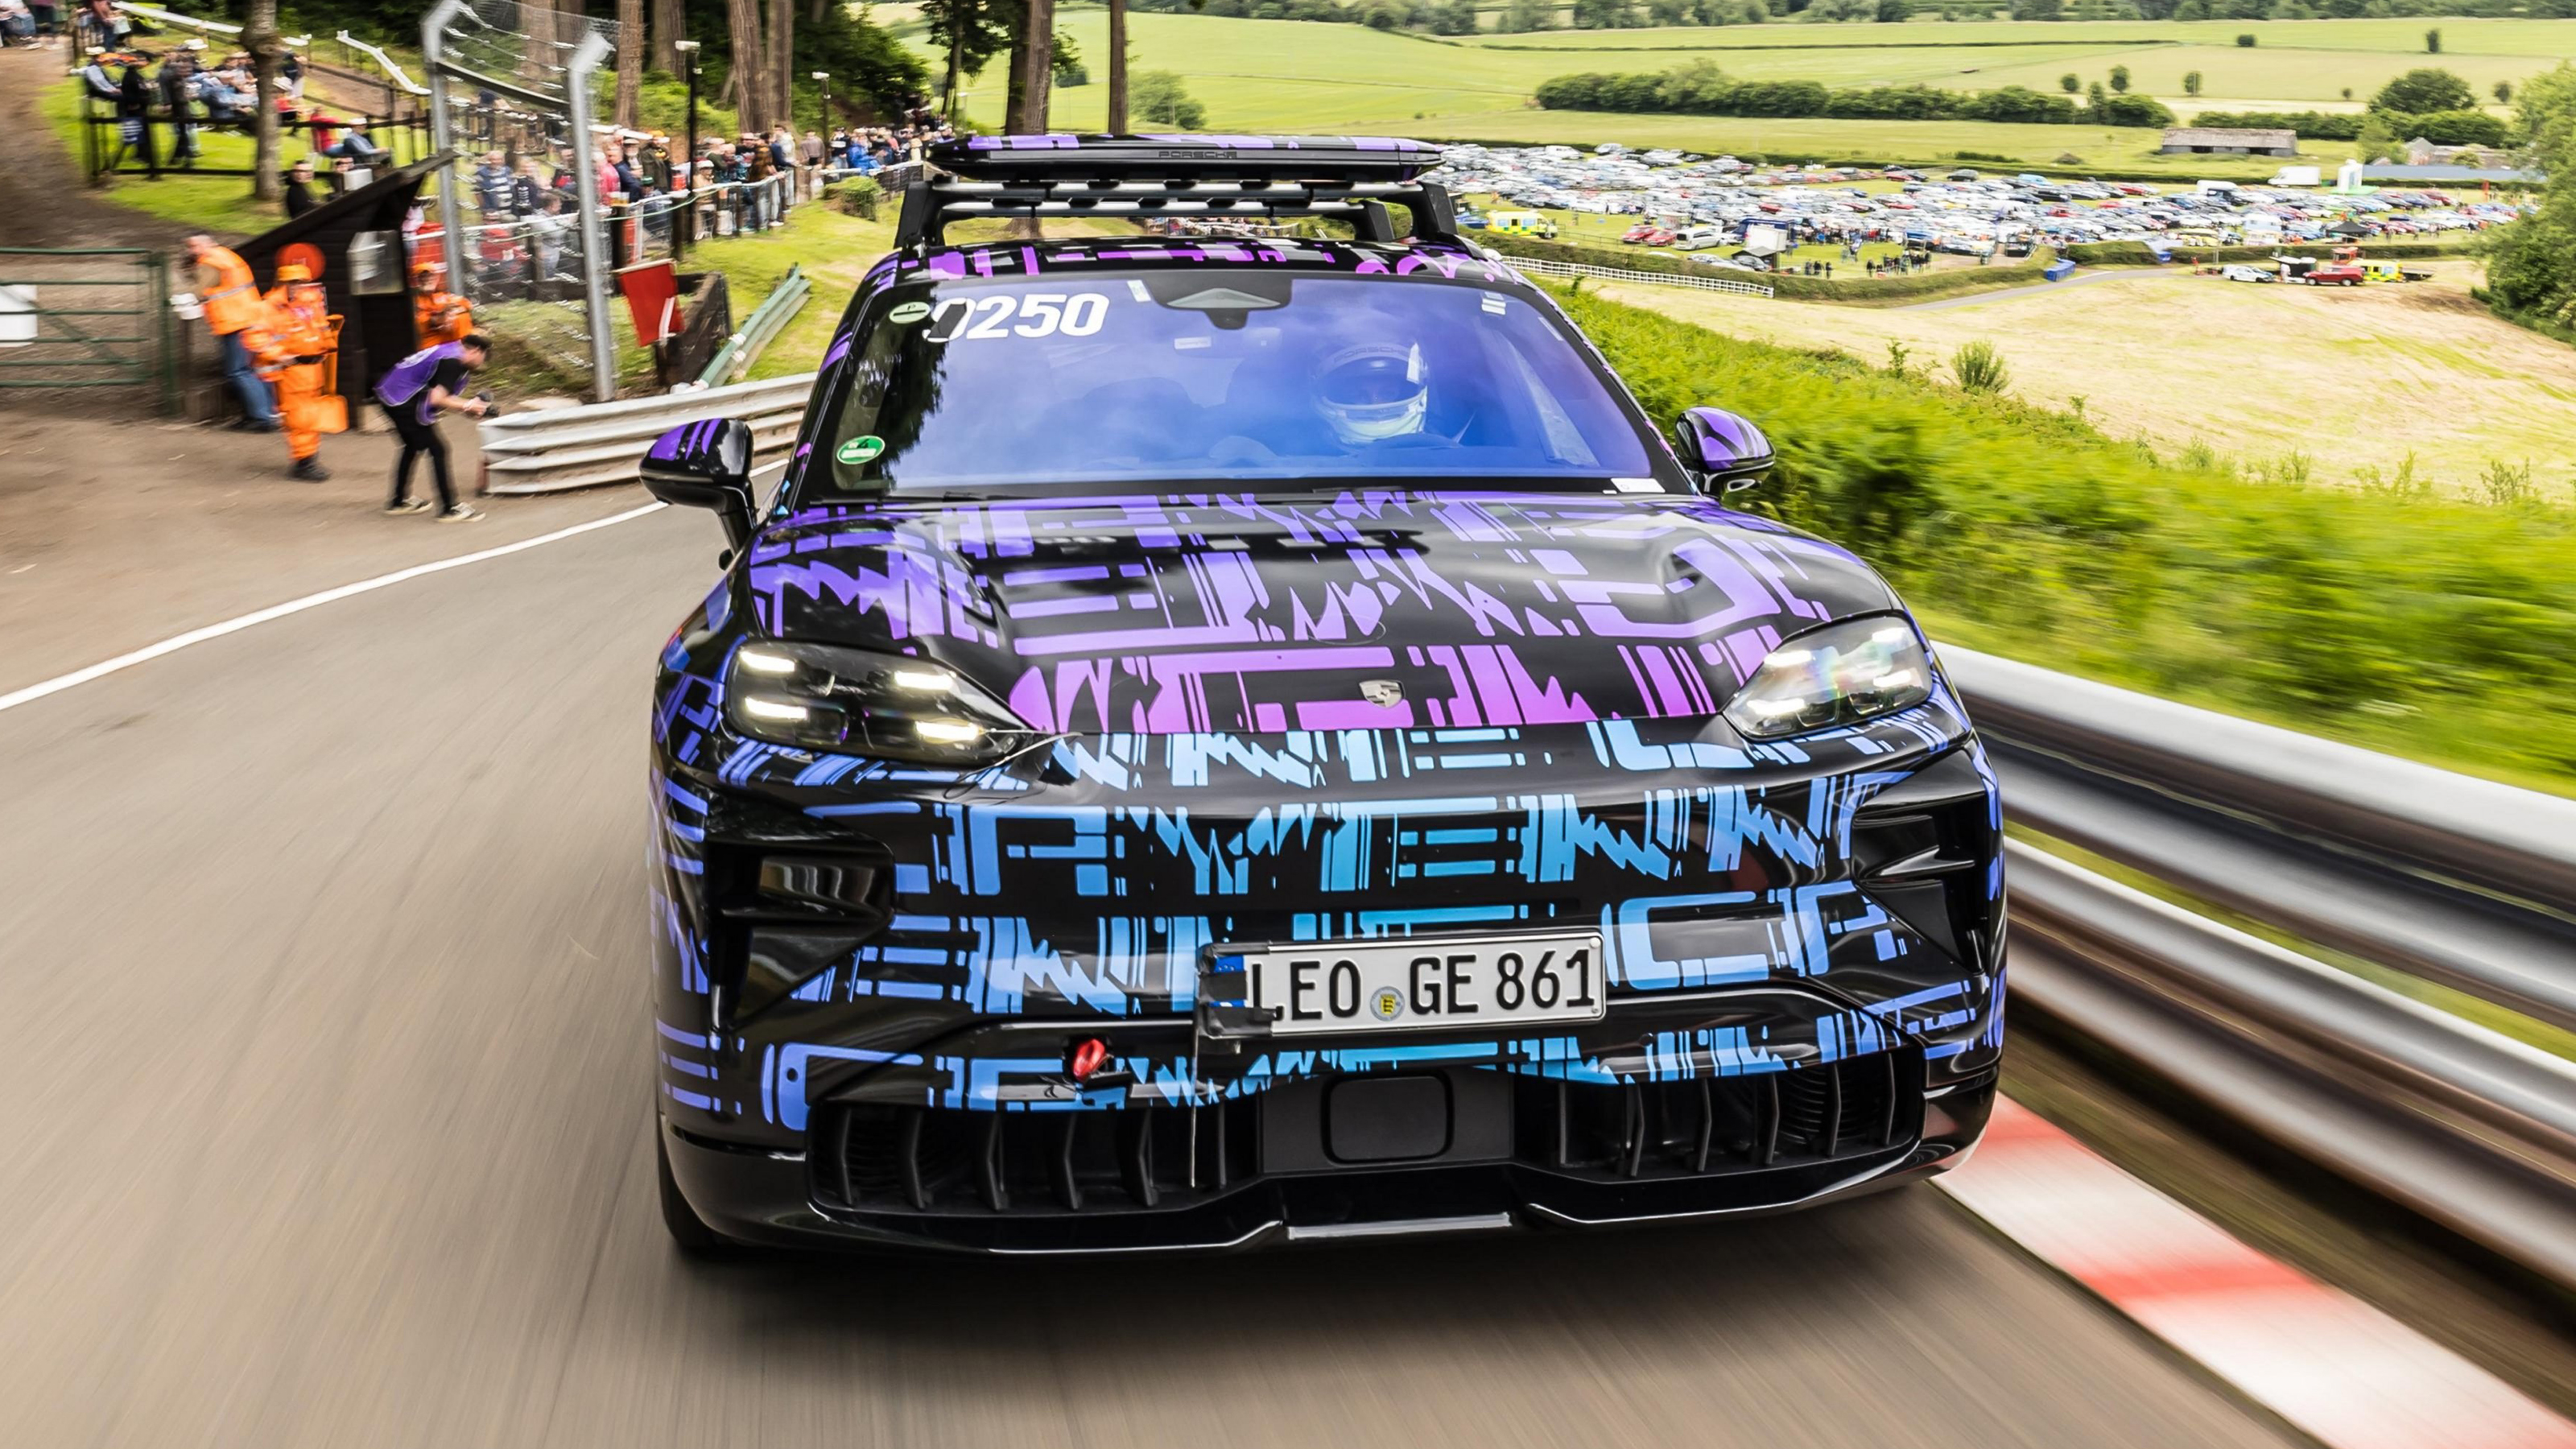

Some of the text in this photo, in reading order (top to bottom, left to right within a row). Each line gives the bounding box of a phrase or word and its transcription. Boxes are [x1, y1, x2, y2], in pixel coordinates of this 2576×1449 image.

[1158, 151, 1237, 159] PORSCHE
[1252, 948, 1596, 1021] LEO GE 861
